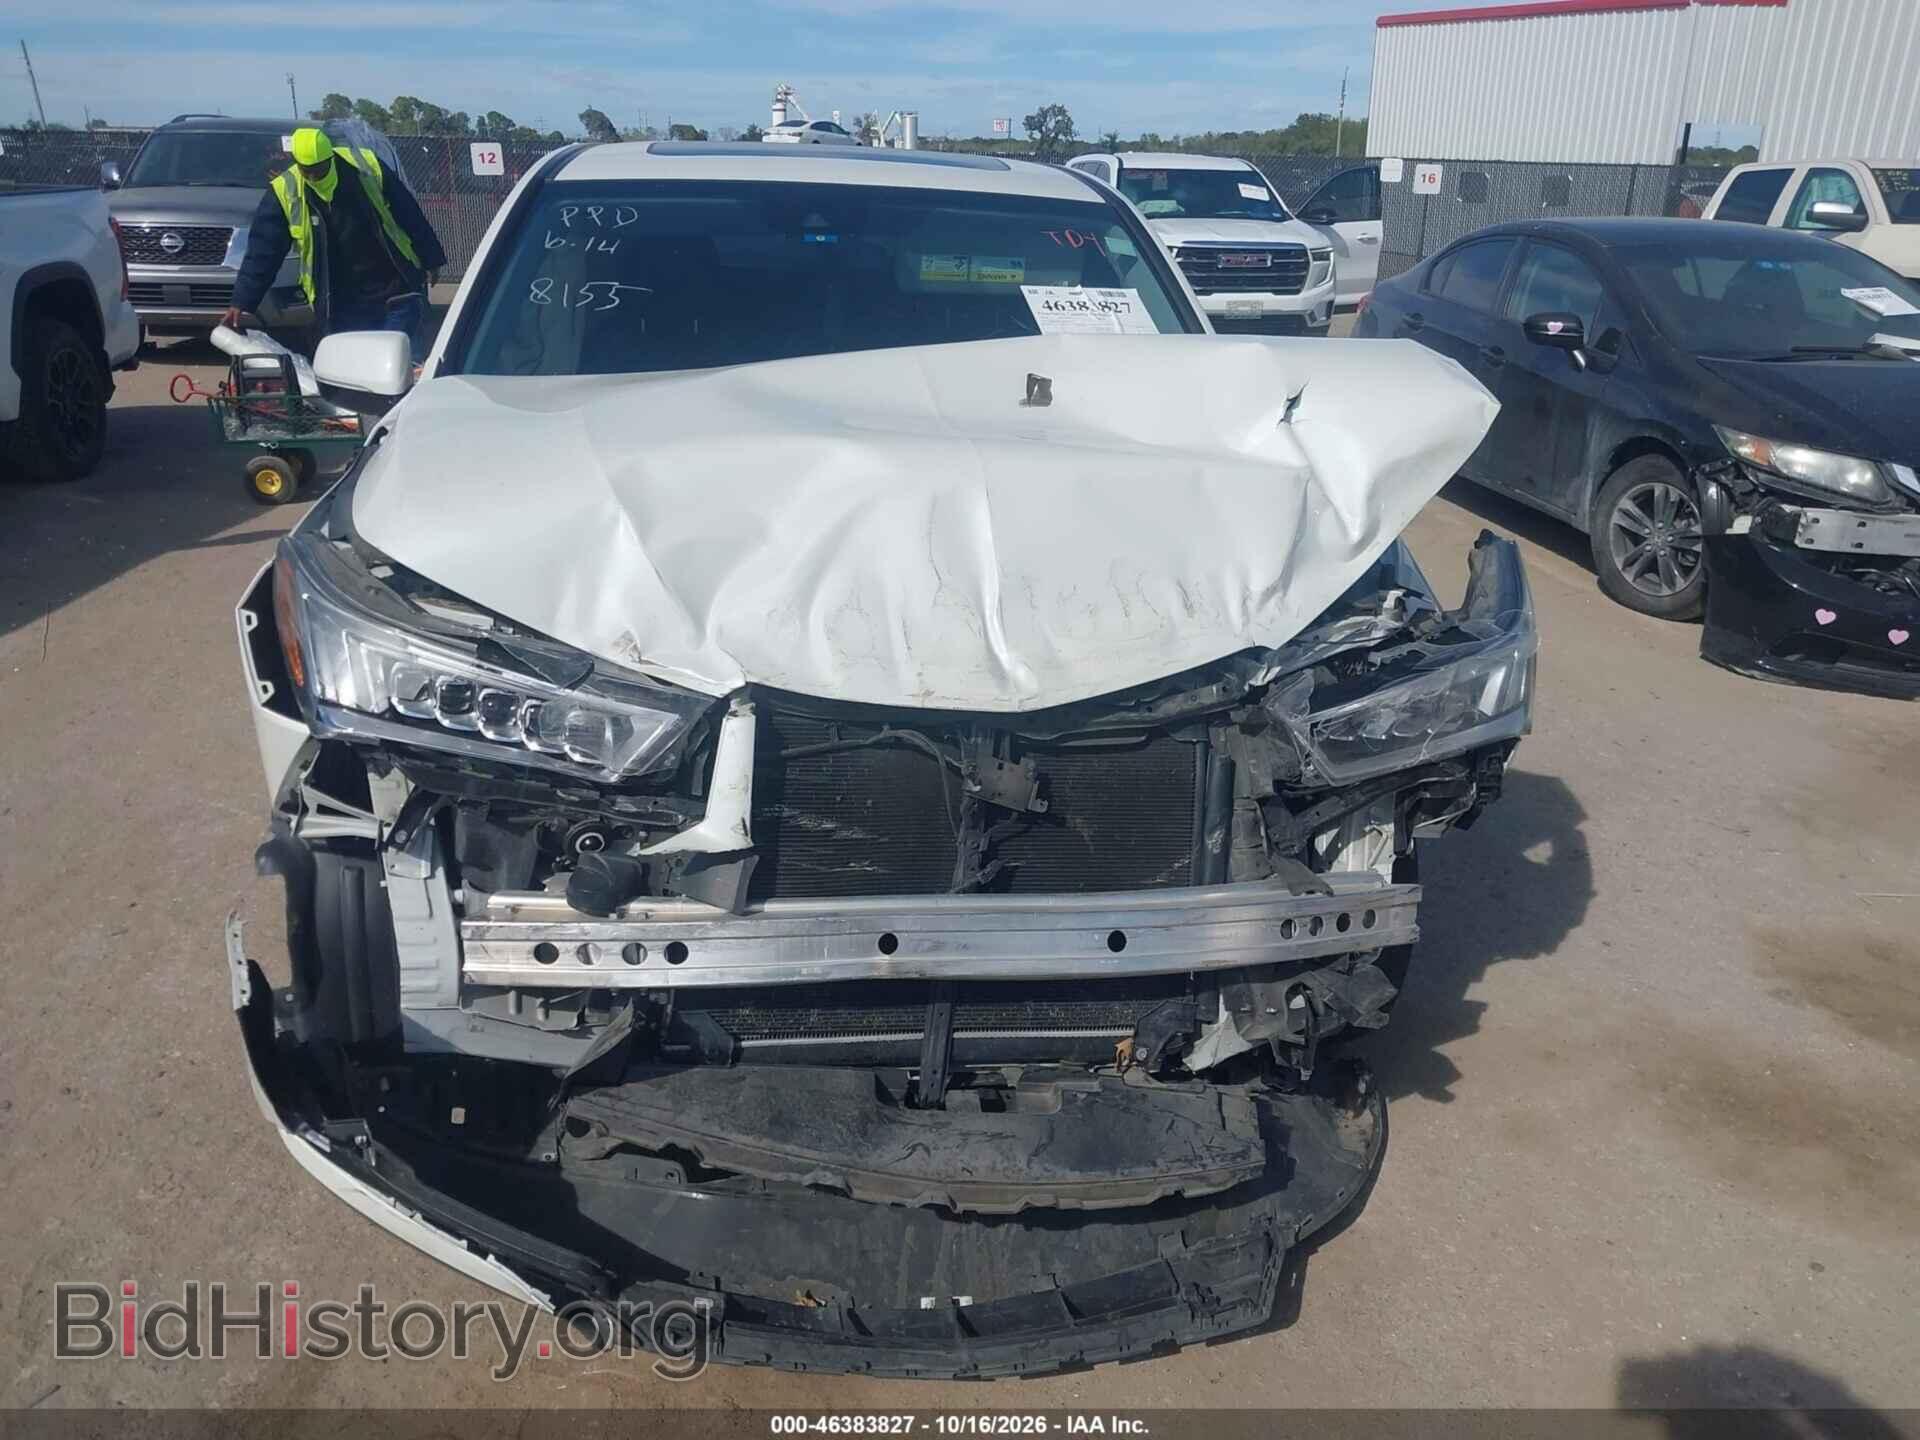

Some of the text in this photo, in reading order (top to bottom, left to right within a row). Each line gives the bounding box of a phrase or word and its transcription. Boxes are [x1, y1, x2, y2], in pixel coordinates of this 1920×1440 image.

[479, 151, 497, 165] 12
[1421, 173, 1436, 185] 16
[1042, 299, 1131, 314] 4638827
